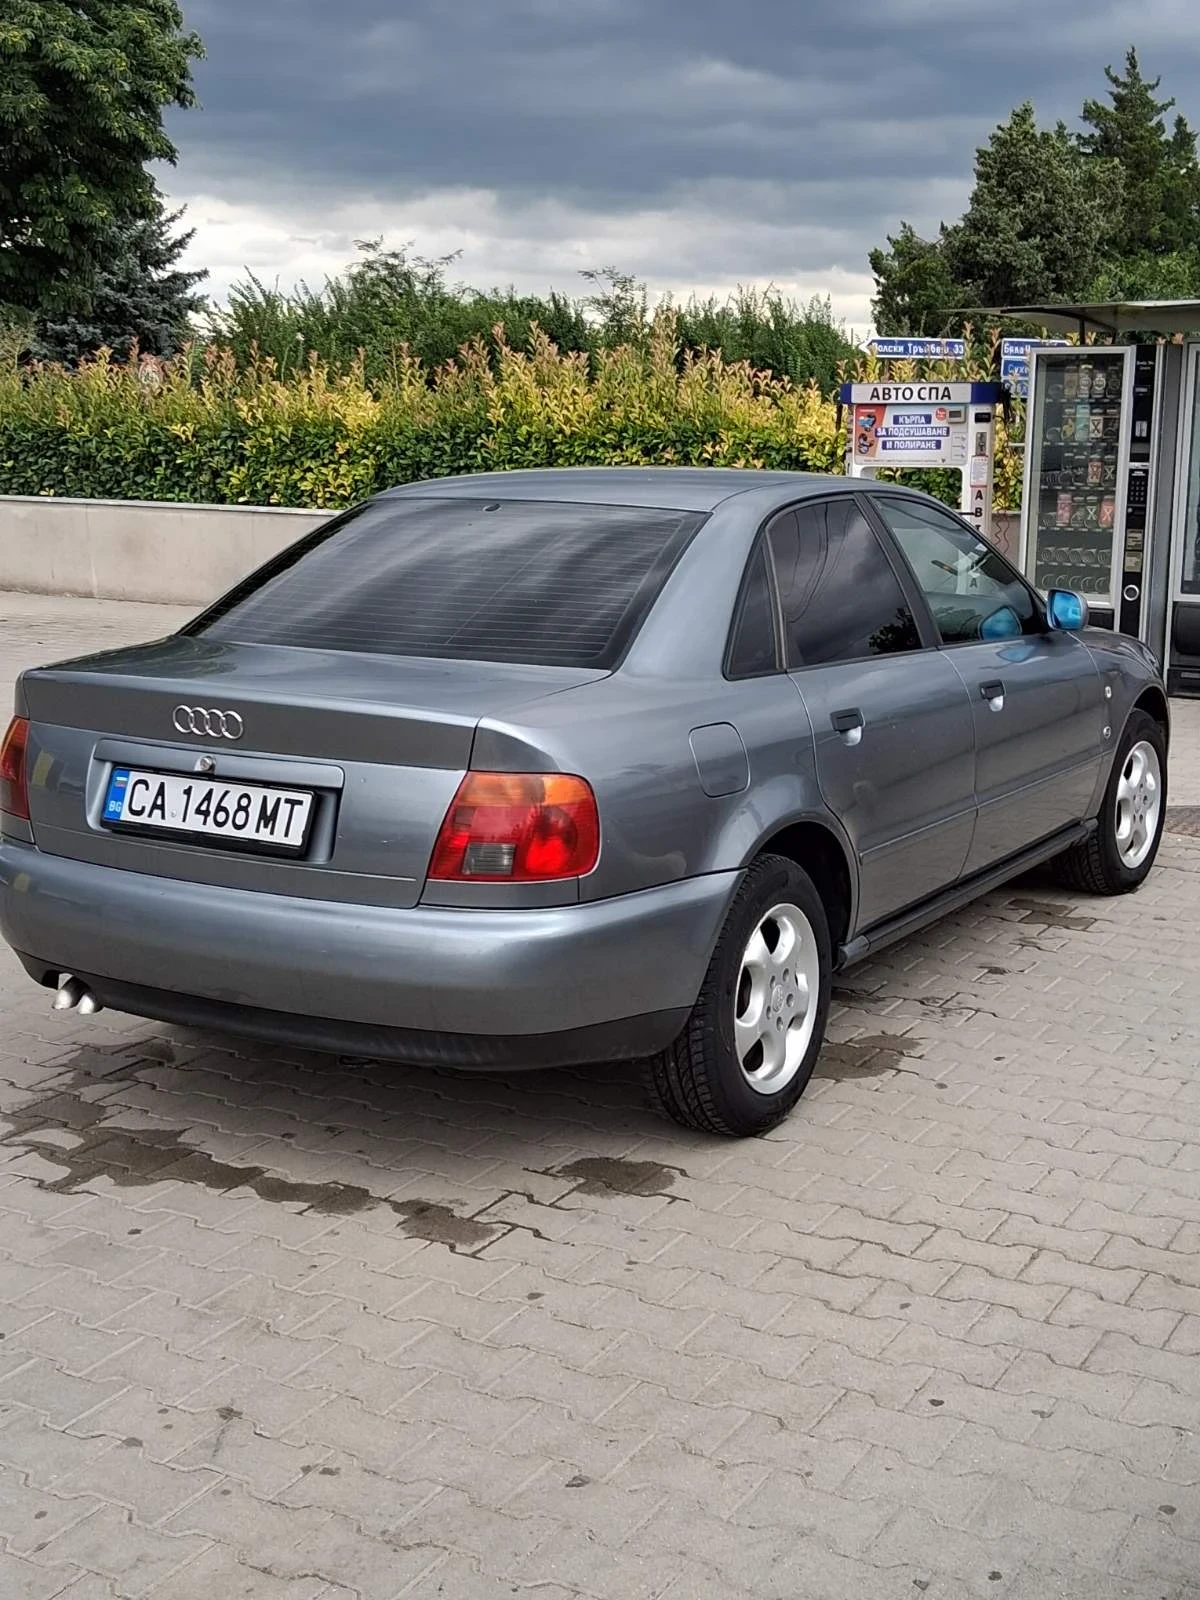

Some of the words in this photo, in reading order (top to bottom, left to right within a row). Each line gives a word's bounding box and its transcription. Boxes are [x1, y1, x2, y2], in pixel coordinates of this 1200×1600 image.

[870, 386, 914, 401] АВТО
[917, 386, 952, 401] СПА
[898, 415, 926, 424] КЪРПА
[876, 428, 887, 437] ЗА
[888, 427, 948, 438] ПОДСУШАВАНЕ
[894, 440, 937, 450] ПОЛИРАНЕ
[109, 801, 122, 813] BG
[127, 778, 166, 820] CA
[182, 785, 252, 831] 1468
[255, 794, 304, 838] MT
